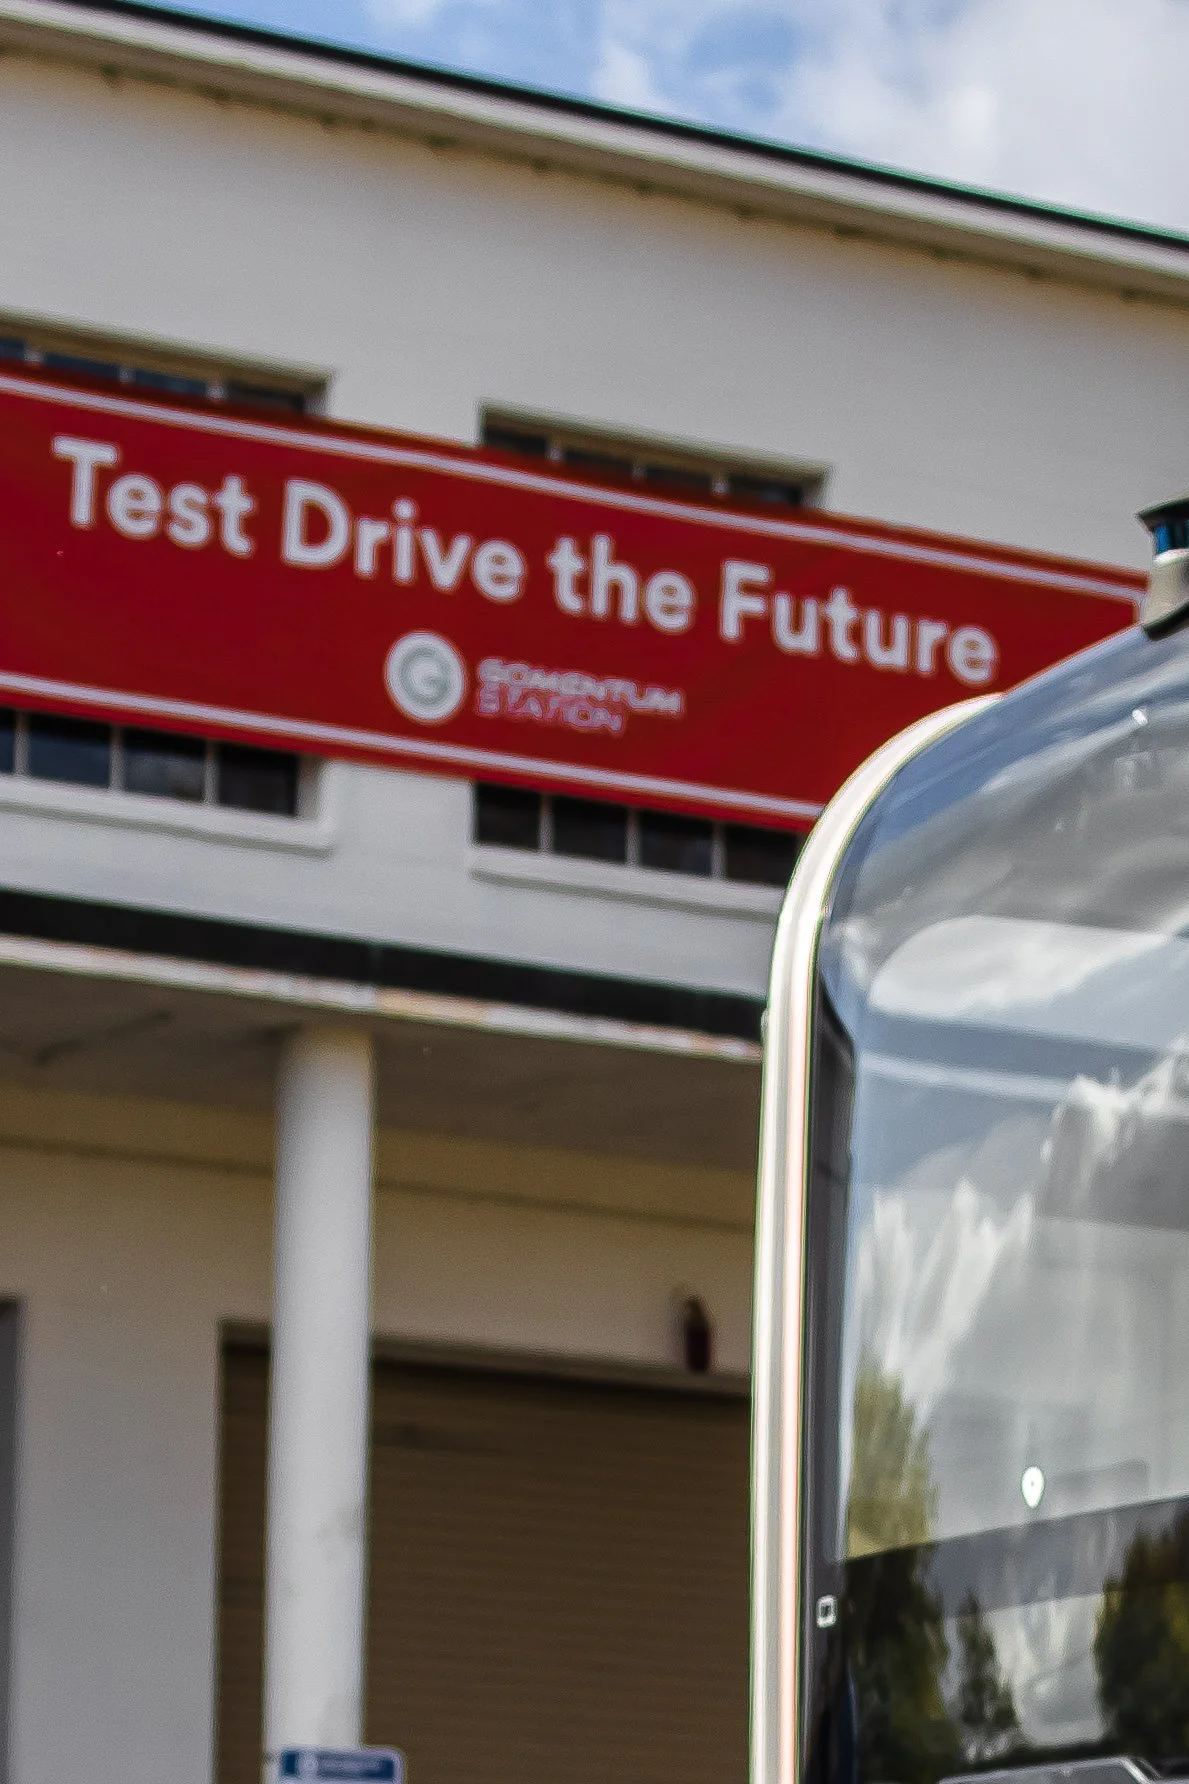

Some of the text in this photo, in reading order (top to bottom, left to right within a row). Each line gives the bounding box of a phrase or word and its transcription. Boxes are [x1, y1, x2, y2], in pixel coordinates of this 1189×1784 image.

[51, 435, 998, 684] Test Drive the Future
